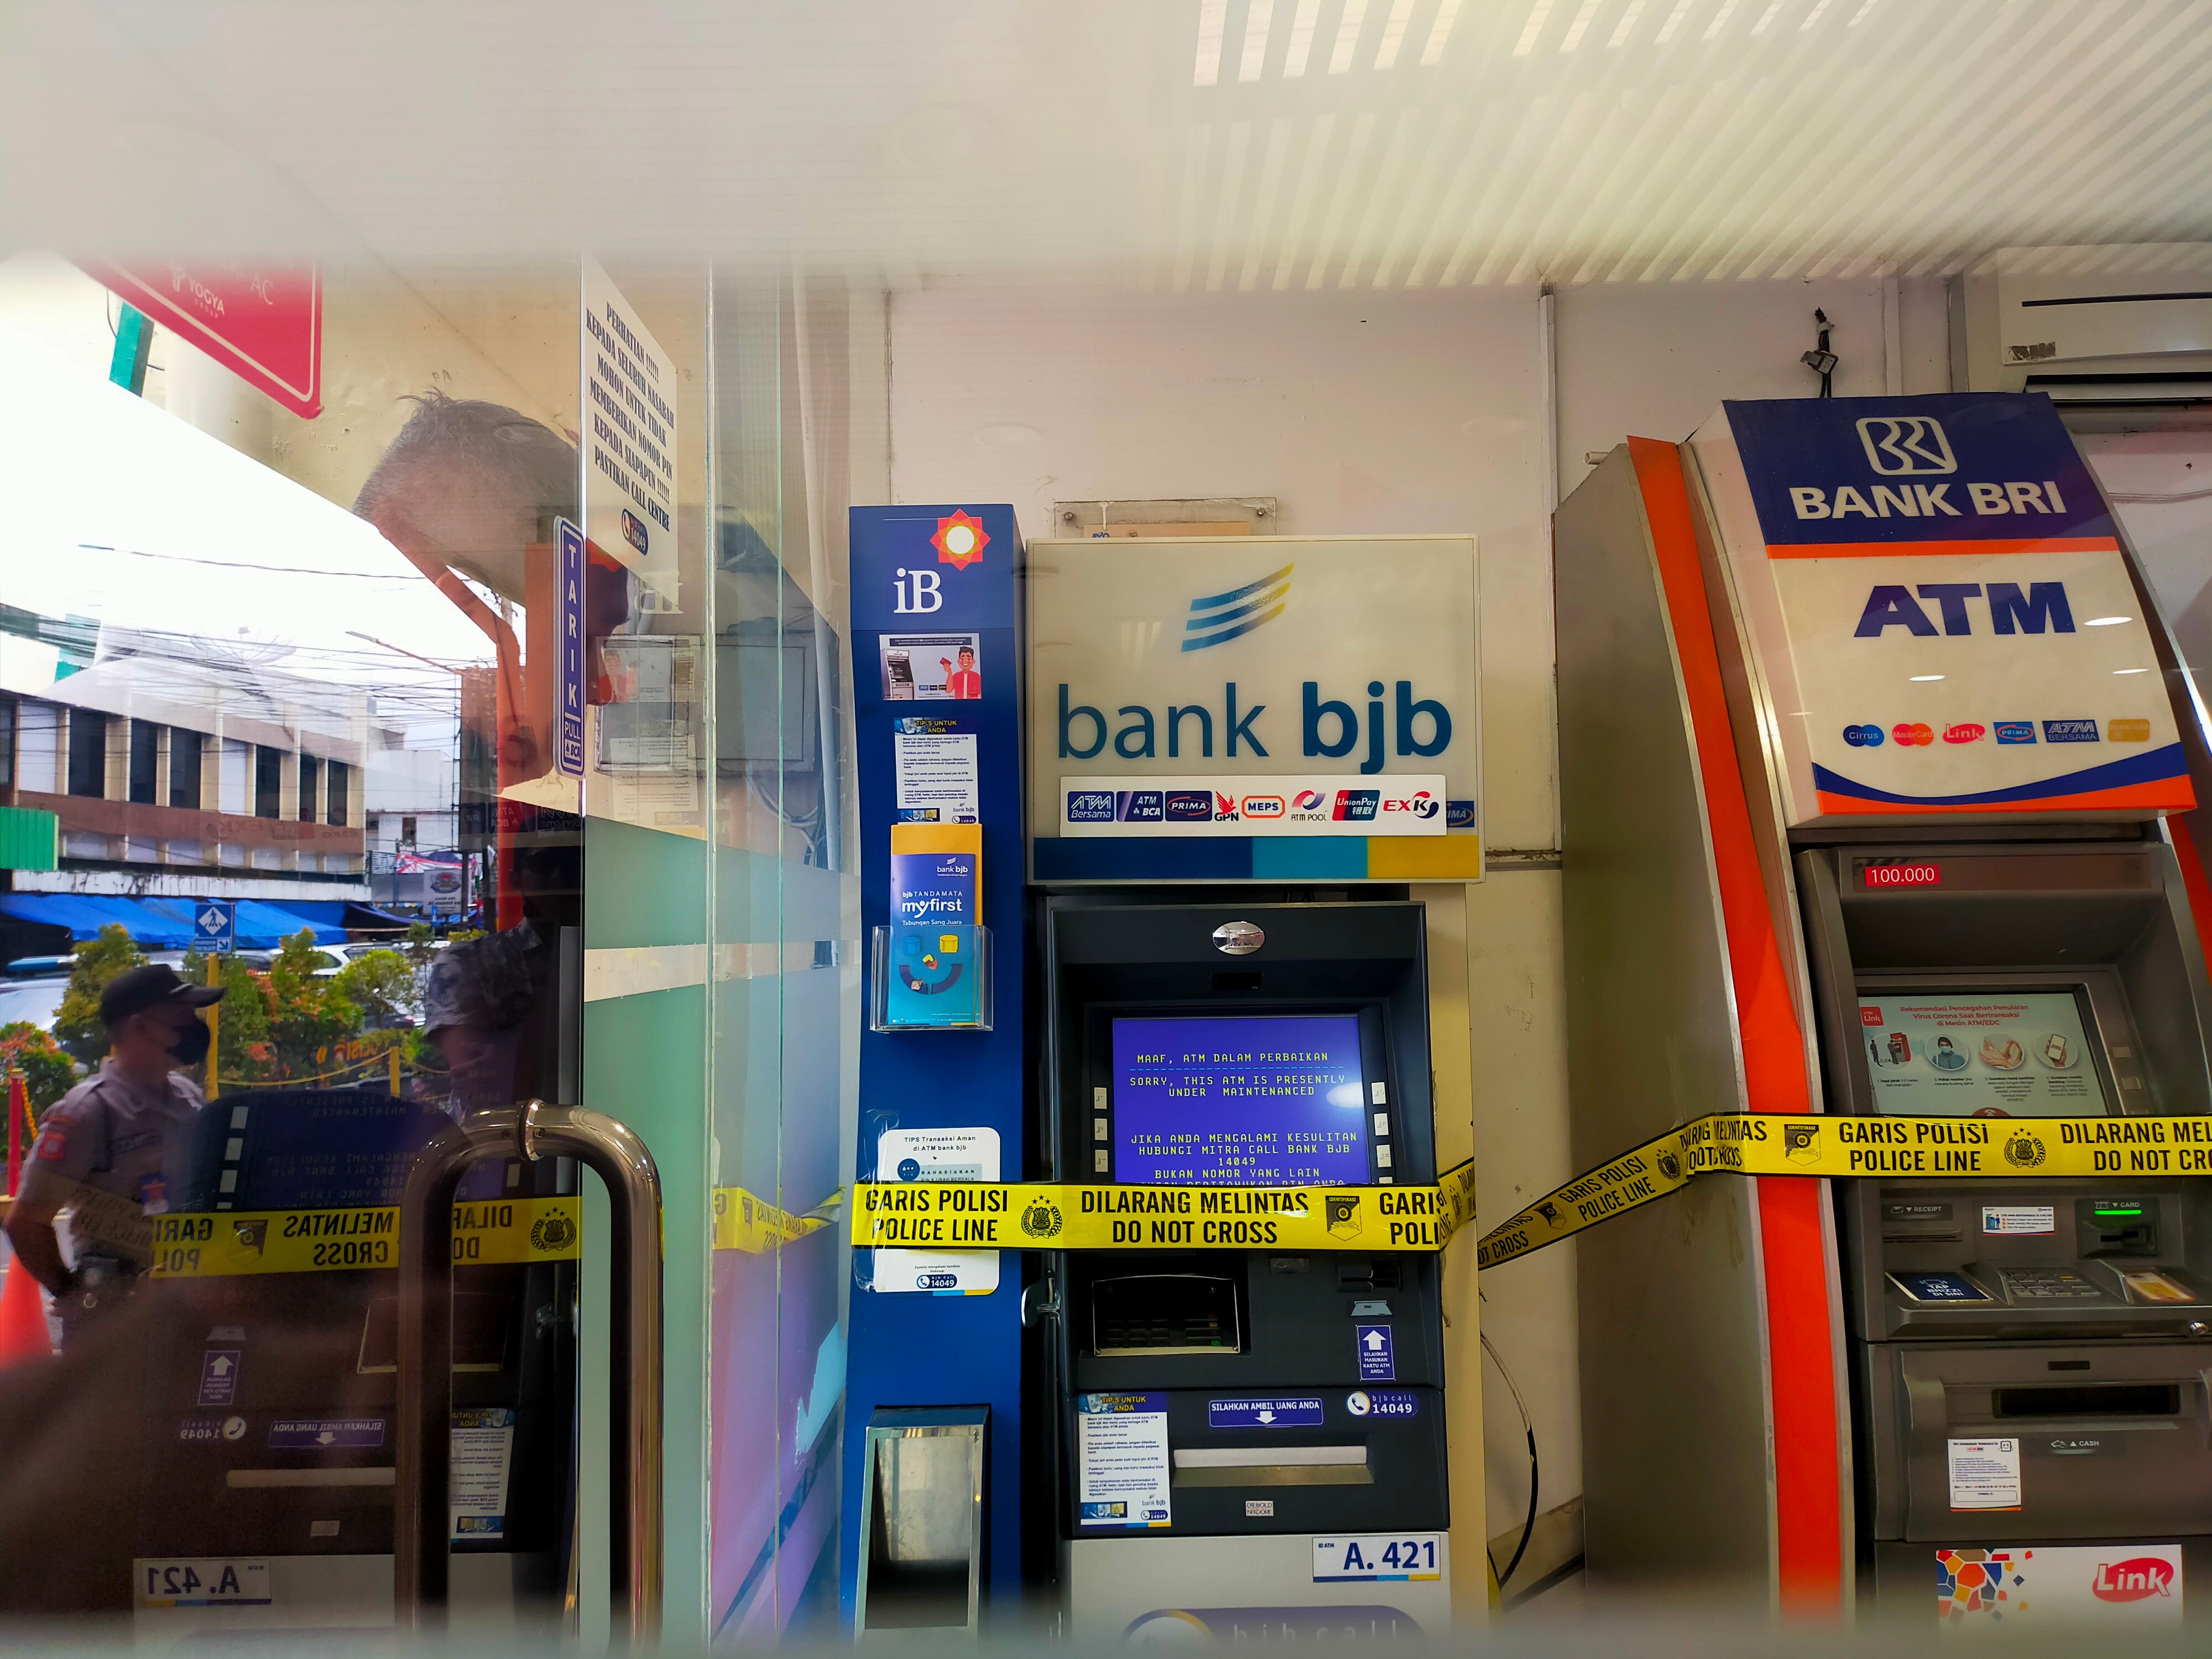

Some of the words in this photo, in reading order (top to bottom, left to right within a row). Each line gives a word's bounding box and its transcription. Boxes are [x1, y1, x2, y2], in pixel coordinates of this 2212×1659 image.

[190, 278, 225, 315] YOGYA
[607, 301, 644, 365] PERHATIAN
[587, 307, 616, 361] KEPADA
[617, 347, 646, 397] SELURUH
[648, 383, 674, 430] NASABAH
[597, 353, 624, 395] MOHON
[626, 386, 646, 424] UNTUK
[648, 411, 667, 447] TIDAK
[590, 377, 637, 444] MEMBERIKAN
[639, 430, 661, 466] NOMOR
[662, 458, 672, 481] PIN
[594, 412, 623, 458] KEPADA
[625, 445, 656, 491] SIAPAPUN
[594, 445, 629, 495] PASTIKAN
[632, 482, 646, 511] CALL
[648, 499, 670, 532] CENTRE
[1789, 484, 1963, 519] BANK
[1967, 482, 2067, 515] BRI
[631, 528, 646, 551] 14049
[893, 567, 943, 613] iB
[1854, 582, 2076, 637] ATM
[565, 722, 580, 740] PULL
[1058, 682, 1269, 758] bank
[1303, 681, 1452, 774] bjb
[1849, 731, 1879, 739] Cirrus
[1945, 723, 1984, 741] Link
[2048, 722, 2094, 733] ATM
[570, 744, 581, 759] BCA
[1071, 795, 1111, 810] ATM
[1138, 796, 1156, 805] ATM
[1248, 802, 1279, 811] MEPS
[1337, 797, 1377, 810] UnionPay
[1071, 810, 1110, 818] Bersama
[1142, 808, 1160, 816] BCA
[1214, 812, 1239, 821] GPN
[1352, 807, 1373, 816] 银联
[956, 865, 968, 874] bjb
[1871, 867, 1934, 884] 100.000
[902, 899, 962, 919] myfirst
[1137, 1054, 1173, 1064] MAAF,
[1183, 1054, 1206, 1063] ATM
[1214, 1053, 1251, 1062] DALAM
[1260, 1052, 1328, 1062] PERBAIKAN
[1130, 1077, 1173, 1087] SORRY,
[1184, 1076, 1213, 1086] THIS
[1223, 1076, 1245, 1085] ATM
[1254, 1076, 1267, 1084] IS
[1276, 1074, 1345, 1084] PRESENTLY
[1168, 1088, 1206, 1097] UNDER
[1223, 1087, 1314, 1097] MAINTENANCED
[1131, 1134, 1161, 1144] JIKA
[1170, 1134, 1200, 1143] ANDA
[1209, 1133, 1277, 1142] MENGALAMI
[1288, 1132, 1357, 1142] KESULITAN
[1839, 1122, 1907, 1144] GARIS
[1916, 1123, 1989, 1144] POLISI
[2060, 1122, 2165, 1144] DILARANG
[1139, 1146, 1192, 1155] HUBUNGI
[1202, 1145, 1239, 1155] MITRA
[1249, 1145, 1279, 1154] CALL
[1288, 1144, 1318, 1154] BANK
[1327, 1144, 1350, 1154] BJB
[1218, 1157, 1256, 1166] 14049
[1850, 1150, 1925, 1171] POLICE
[1935, 1150, 1981, 1171] LINE
[2094, 1150, 2121, 1171] DO
[2130, 1150, 2171, 1171] NOT
[1155, 1169, 1193, 1179] BUKAN
[1202, 1169, 1240, 1178] NOMOR
[1250, 1168, 1280, 1178] YANG
[1289, 1168, 1319, 1177] LAIN
[1559, 1177, 1603, 1204] GARIS
[1603, 1156, 1648, 1182] POLISI
[865, 1190, 930, 1211] GARIS
[939, 1190, 1008, 1212] POLISI
[1081, 1191, 1190, 1214] DILARANG
[1201, 1192, 1308, 1215] MELINTAS
[1578, 1190, 1624, 1222] POLICE
[1626, 1177, 1656, 1203] LINE
[872, 1218, 943, 1240] POLICE
[952, 1219, 998, 1241] LINE
[1113, 1220, 1141, 1243] DO
[1151, 1220, 1194, 1243] NOT
[1203, 1221, 1277, 1244] CROSS
[1494, 1231, 1529, 1259] CROSS
[1212, 1402, 1249, 1411] SILAHKAN
[1251, 1402, 1275, 1411] AMBIL
[1276, 1401, 1297, 1410] UANG
[1299, 1401, 1319, 1410] ANDA
[1373, 1403, 1412, 1414] 14049
[1343, 1542, 1374, 1571] A.
[1382, 1541, 1435, 1570] 421
[2098, 1563, 2171, 1597] Link
